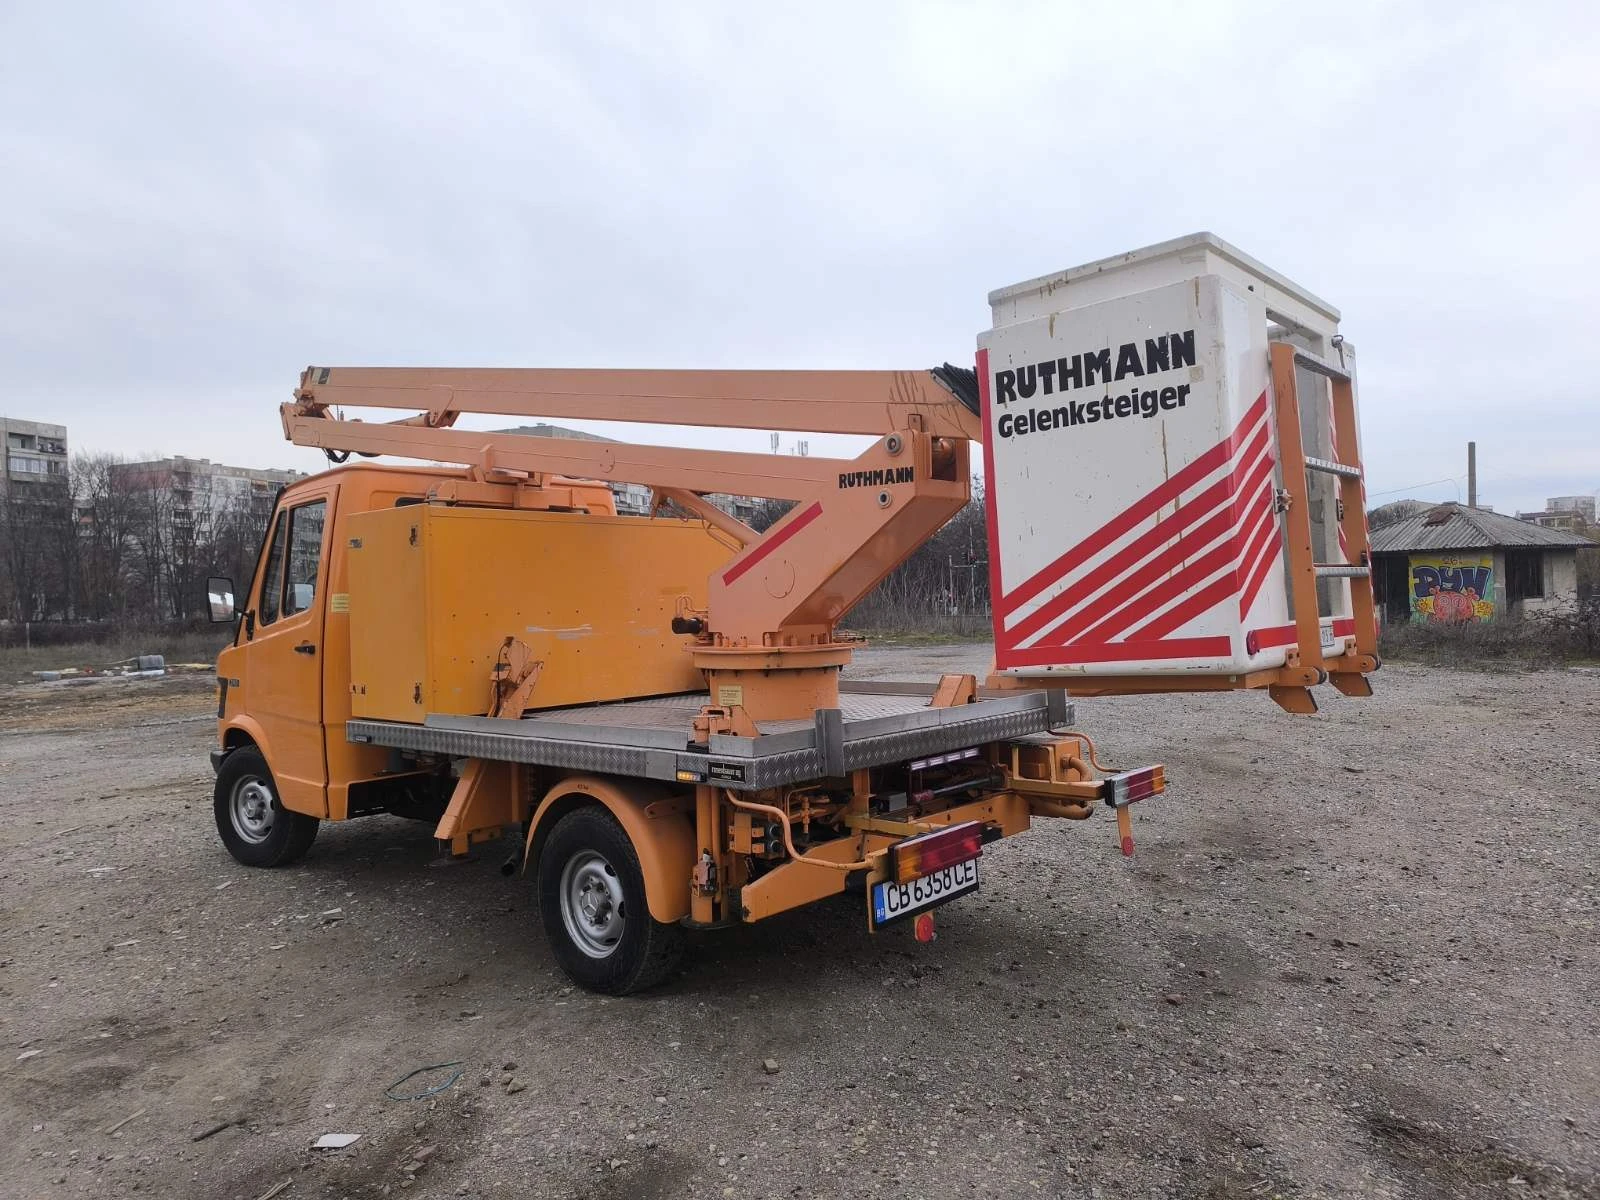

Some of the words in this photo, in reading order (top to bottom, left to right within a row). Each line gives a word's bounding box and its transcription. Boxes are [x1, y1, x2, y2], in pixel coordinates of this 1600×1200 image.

[995, 329, 1196, 404] RUTHMANN
[998, 383, 1191, 438] Gelenksteiger
[838, 466, 914, 489] RUTHMANN
[887, 883, 910, 912] CB
[914, 867, 952, 902] 6358
